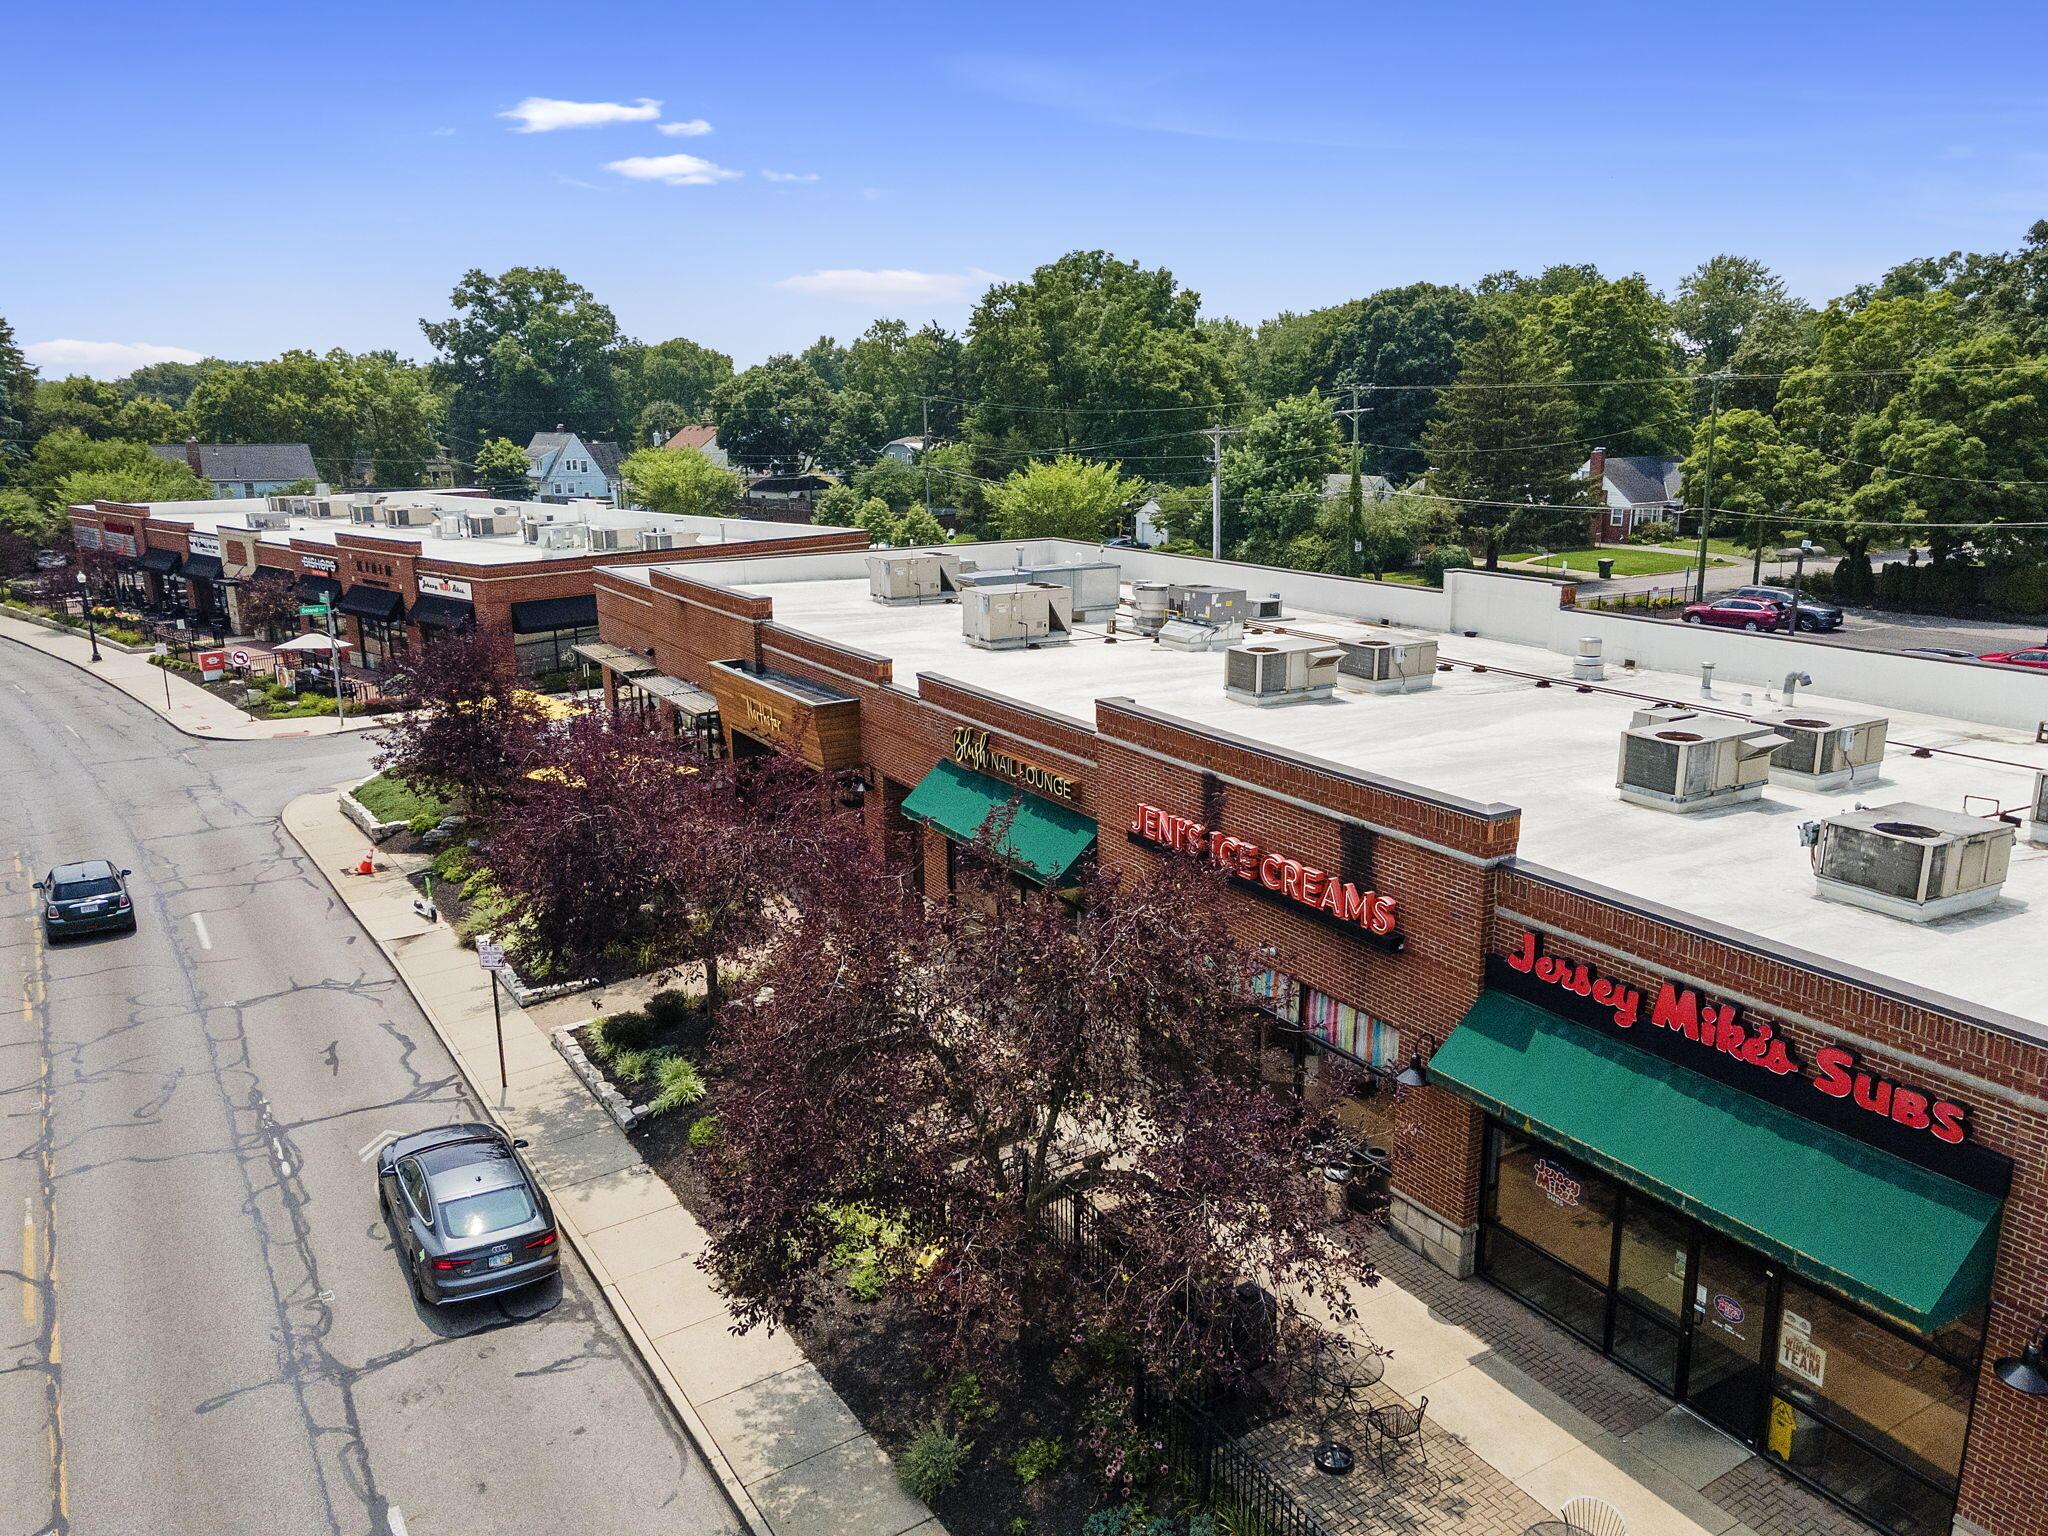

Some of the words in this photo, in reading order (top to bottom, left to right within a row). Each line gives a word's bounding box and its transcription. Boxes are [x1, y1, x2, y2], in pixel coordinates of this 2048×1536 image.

[302, 556, 336, 572] BISHOPS
[952, 727, 990, 770] Blush
[991, 752, 1017, 778] NAIL
[1131, 802, 1204, 855] JENI'S
[1209, 830, 1259, 880] ICE
[1259, 853, 1397, 936] CREAMS
[1507, 932, 1640, 1028] Jersey
[1651, 982, 1800, 1076] Mike's
[1534, 1159, 1580, 1197] Jersey
[1783, 1344, 1821, 1379] TEAM
